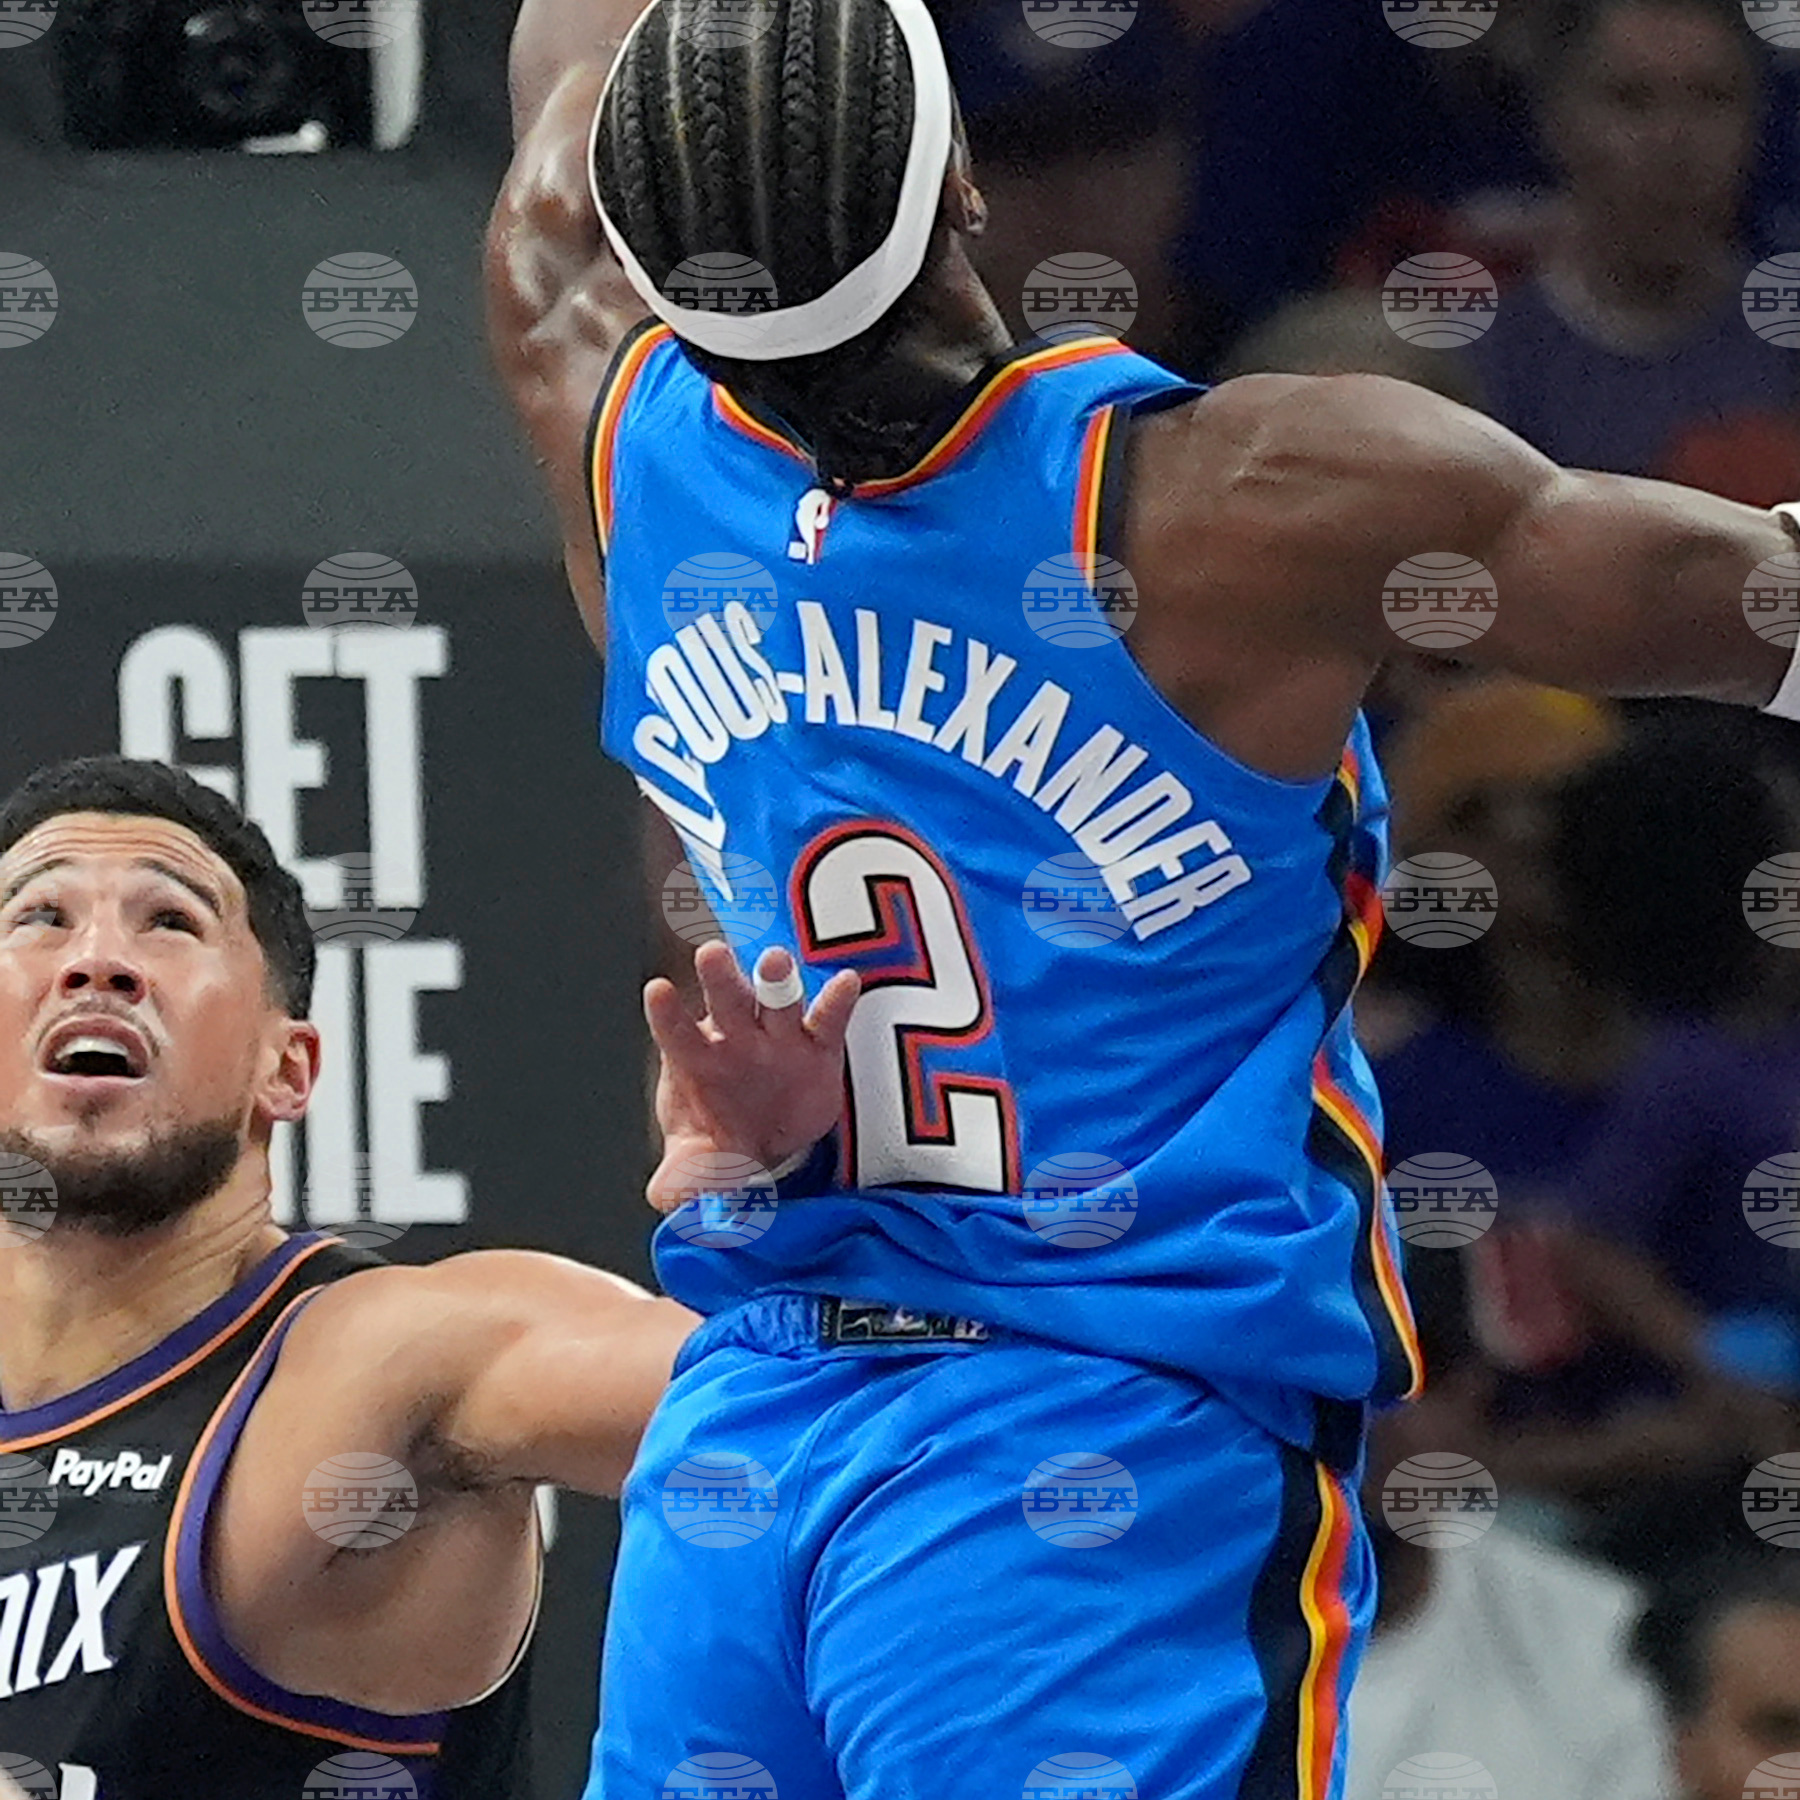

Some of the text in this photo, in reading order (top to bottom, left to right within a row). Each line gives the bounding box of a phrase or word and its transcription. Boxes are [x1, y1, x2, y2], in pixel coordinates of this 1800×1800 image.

[118, 624, 449, 909] GET
[791, 816, 1019, 1196] 2
[48, 1449, 176, 1497] PayPal
